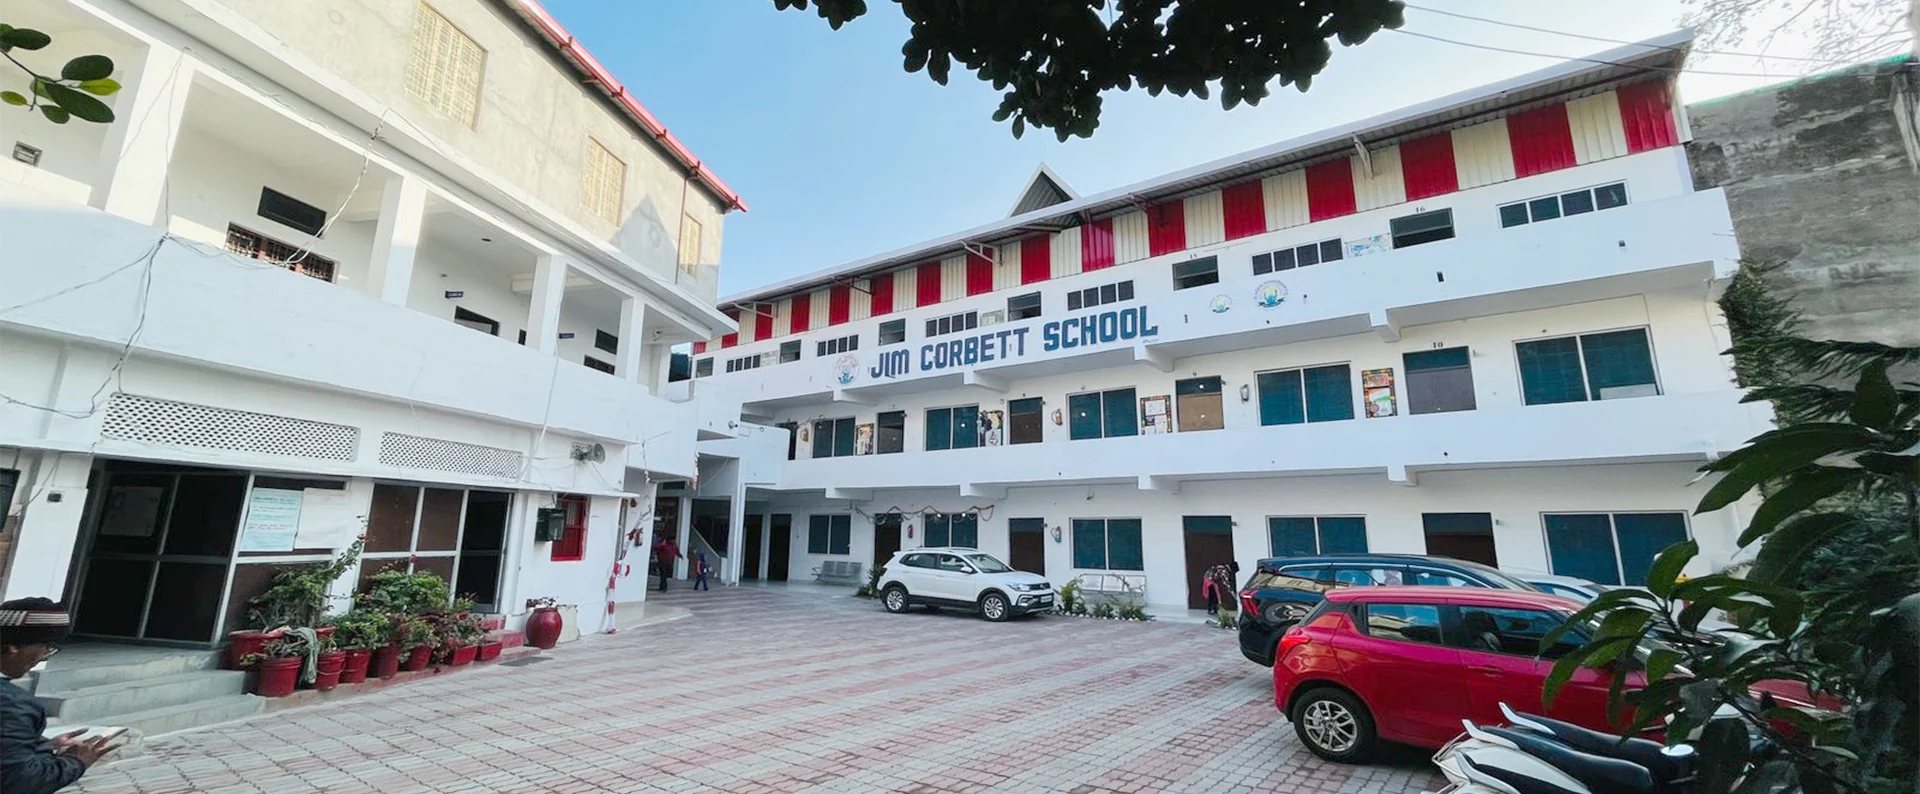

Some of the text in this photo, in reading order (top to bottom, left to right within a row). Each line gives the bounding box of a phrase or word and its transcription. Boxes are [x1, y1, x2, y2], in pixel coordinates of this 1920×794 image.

[870, 305, 1158, 378] JIM CORBETT SCHOOL
[1432, 341, 1444, 349] 10
